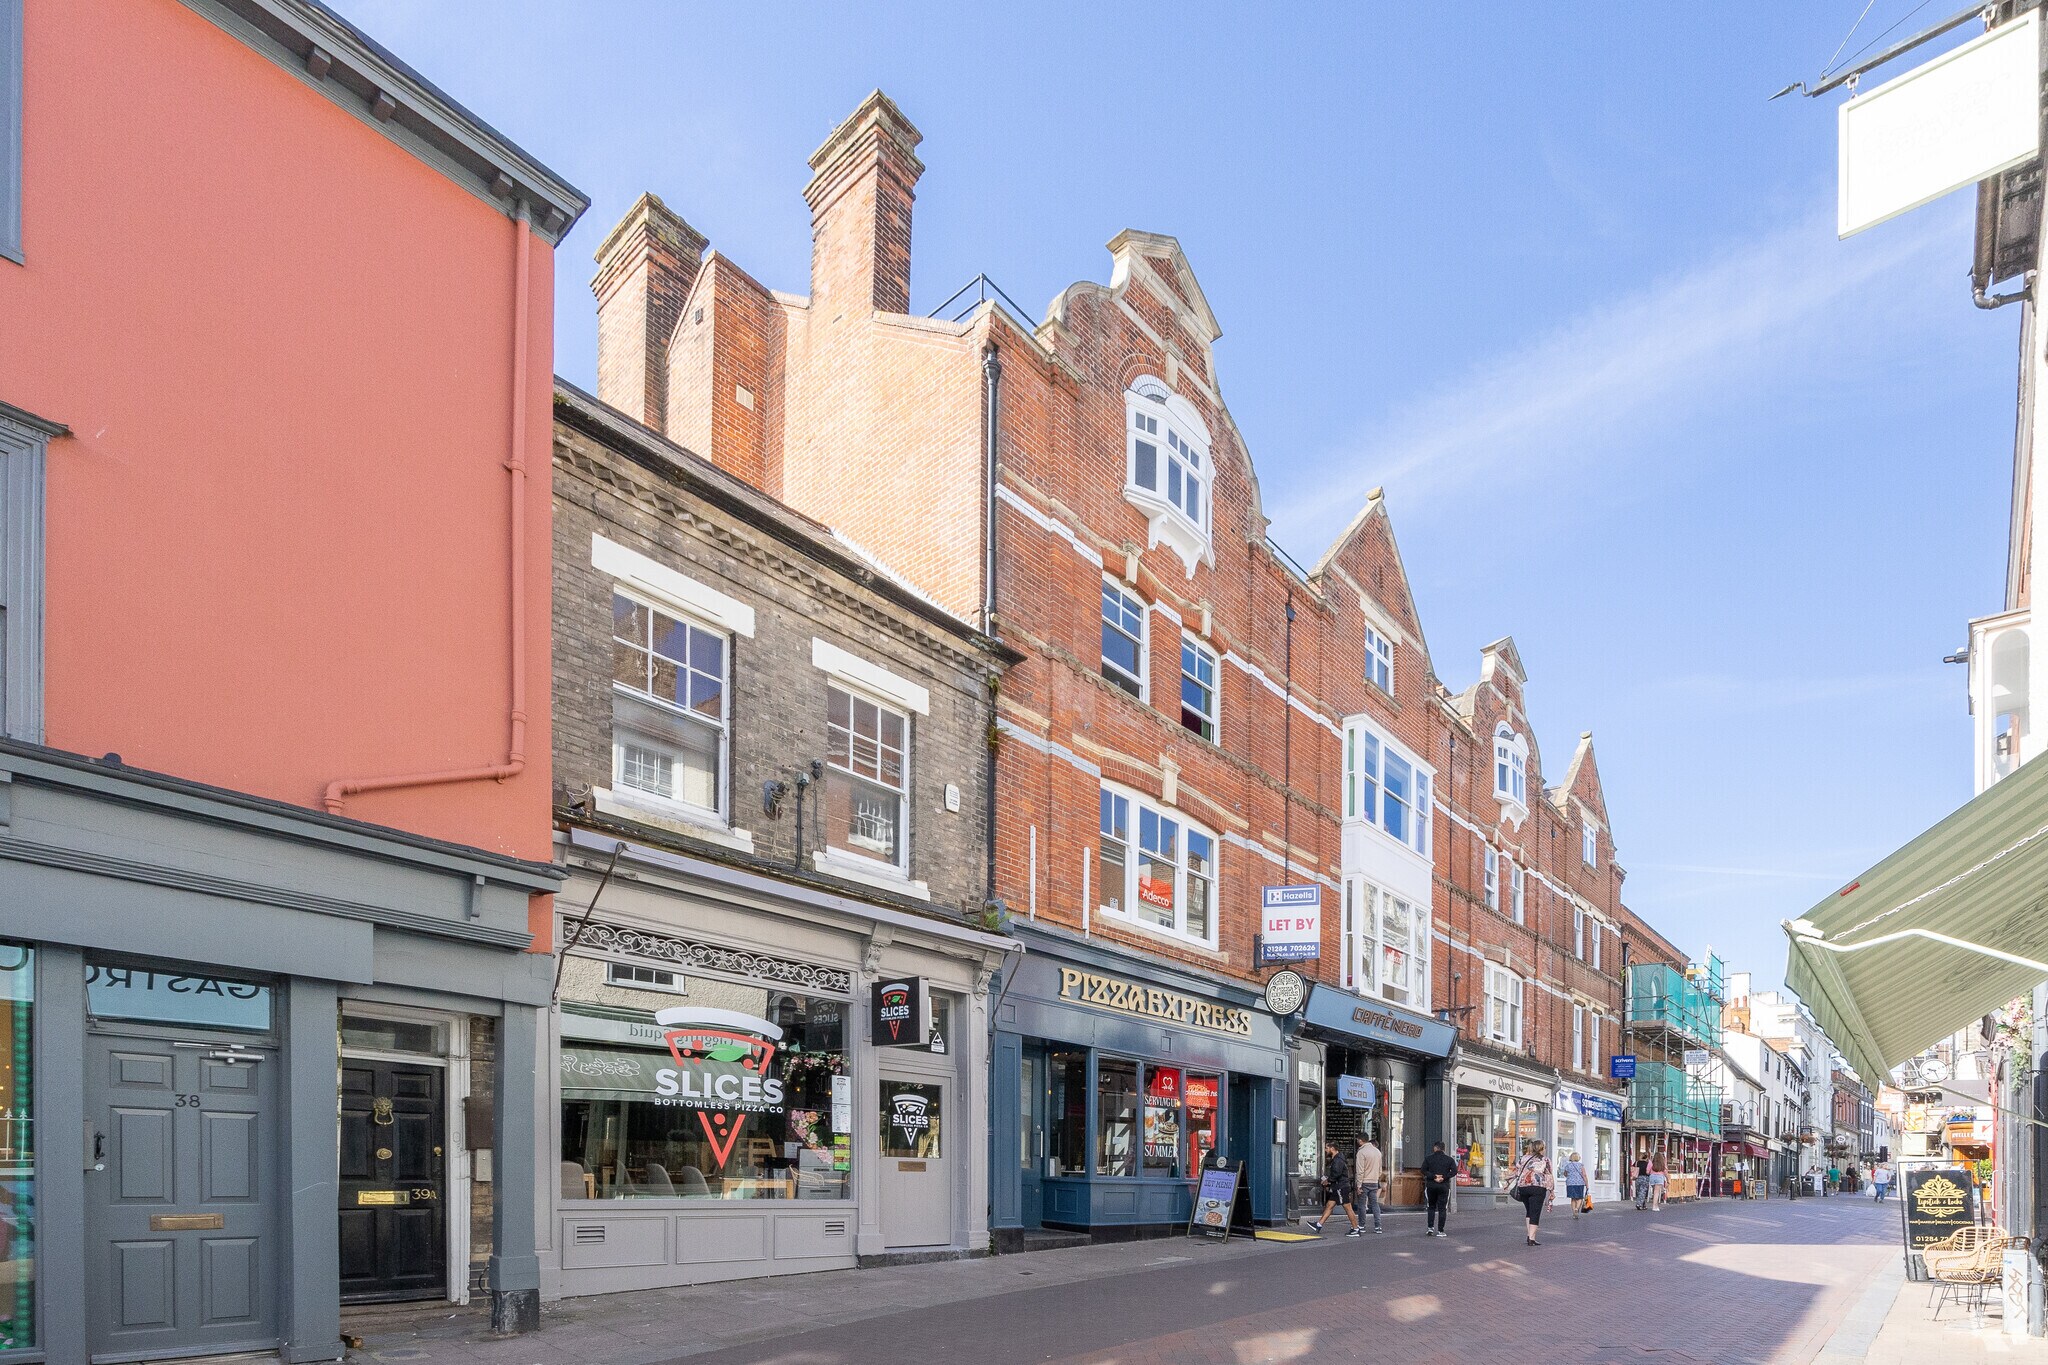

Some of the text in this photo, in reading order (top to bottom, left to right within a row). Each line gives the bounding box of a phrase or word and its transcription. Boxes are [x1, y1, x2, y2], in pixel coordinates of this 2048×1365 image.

[1142, 889, 1169, 906] Adecco
[1283, 892, 1313, 900] Hazells
[1269, 918, 1315, 931] LET BY
[881, 1005, 909, 1017] SLICES
[1390, 1018, 1423, 1039] NERO
[654, 1068, 784, 1105] SLICES
[1498, 1077, 1515, 1092] Quest
[1347, 1089, 1367, 1099] NERO
[175, 1094, 200, 1108] 38
[654, 1098, 784, 1114] BOTTOMLESS PIZZA CO
[1145, 1095, 1171, 1107] SERVING
[892, 1114, 929, 1125] SLICES
[1144, 1144, 1178, 1158] SUMMER
[411, 1188, 438, 1200] 39A
